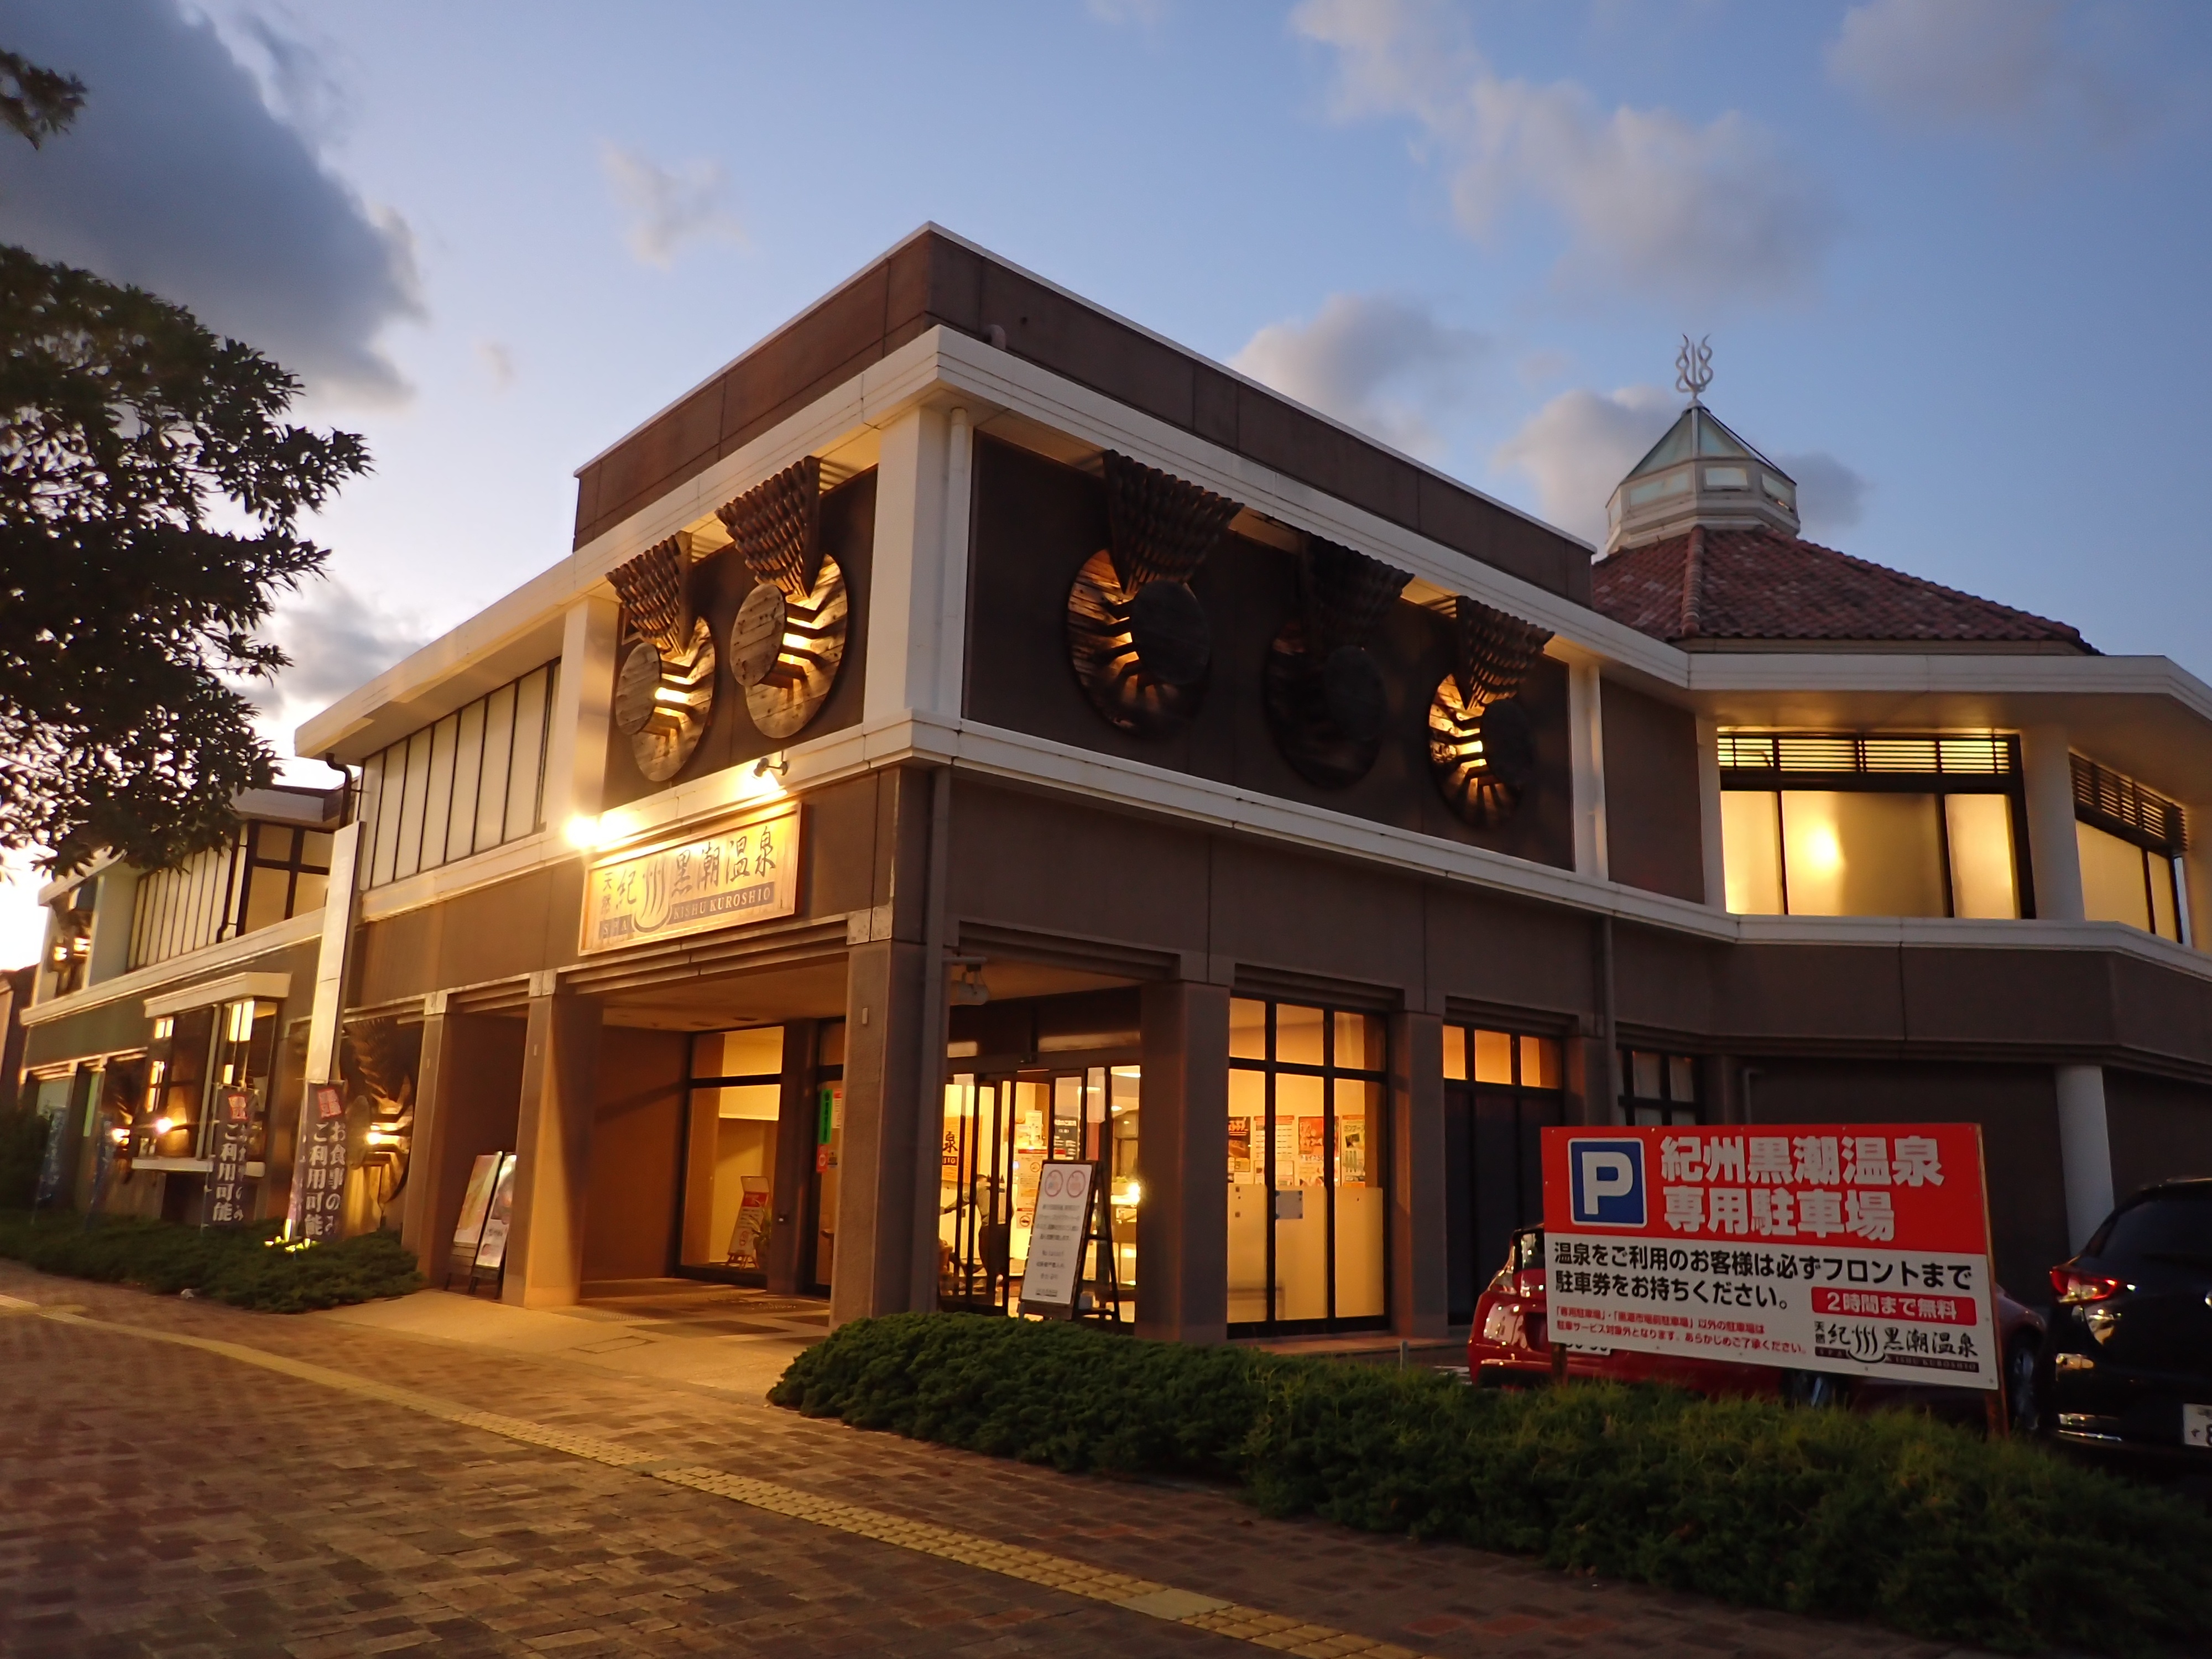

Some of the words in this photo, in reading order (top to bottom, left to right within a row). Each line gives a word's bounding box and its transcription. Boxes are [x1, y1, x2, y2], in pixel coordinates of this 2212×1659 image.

[709, 887, 771, 911] KUROSHIO
[1582, 1151, 1633, 1215] P
[1660, 1135, 1945, 1187] 紀州黒潮温泉
[1662, 1186, 1895, 1242] 専用駐車場
[1554, 1241, 1971, 1290] 温泉をご利用のお客様は必ずフロントまで
[1556, 1270, 1787, 1310] 駐車券をお持ちください。
[1827, 1291, 1957, 1321] 2時間まで無料
